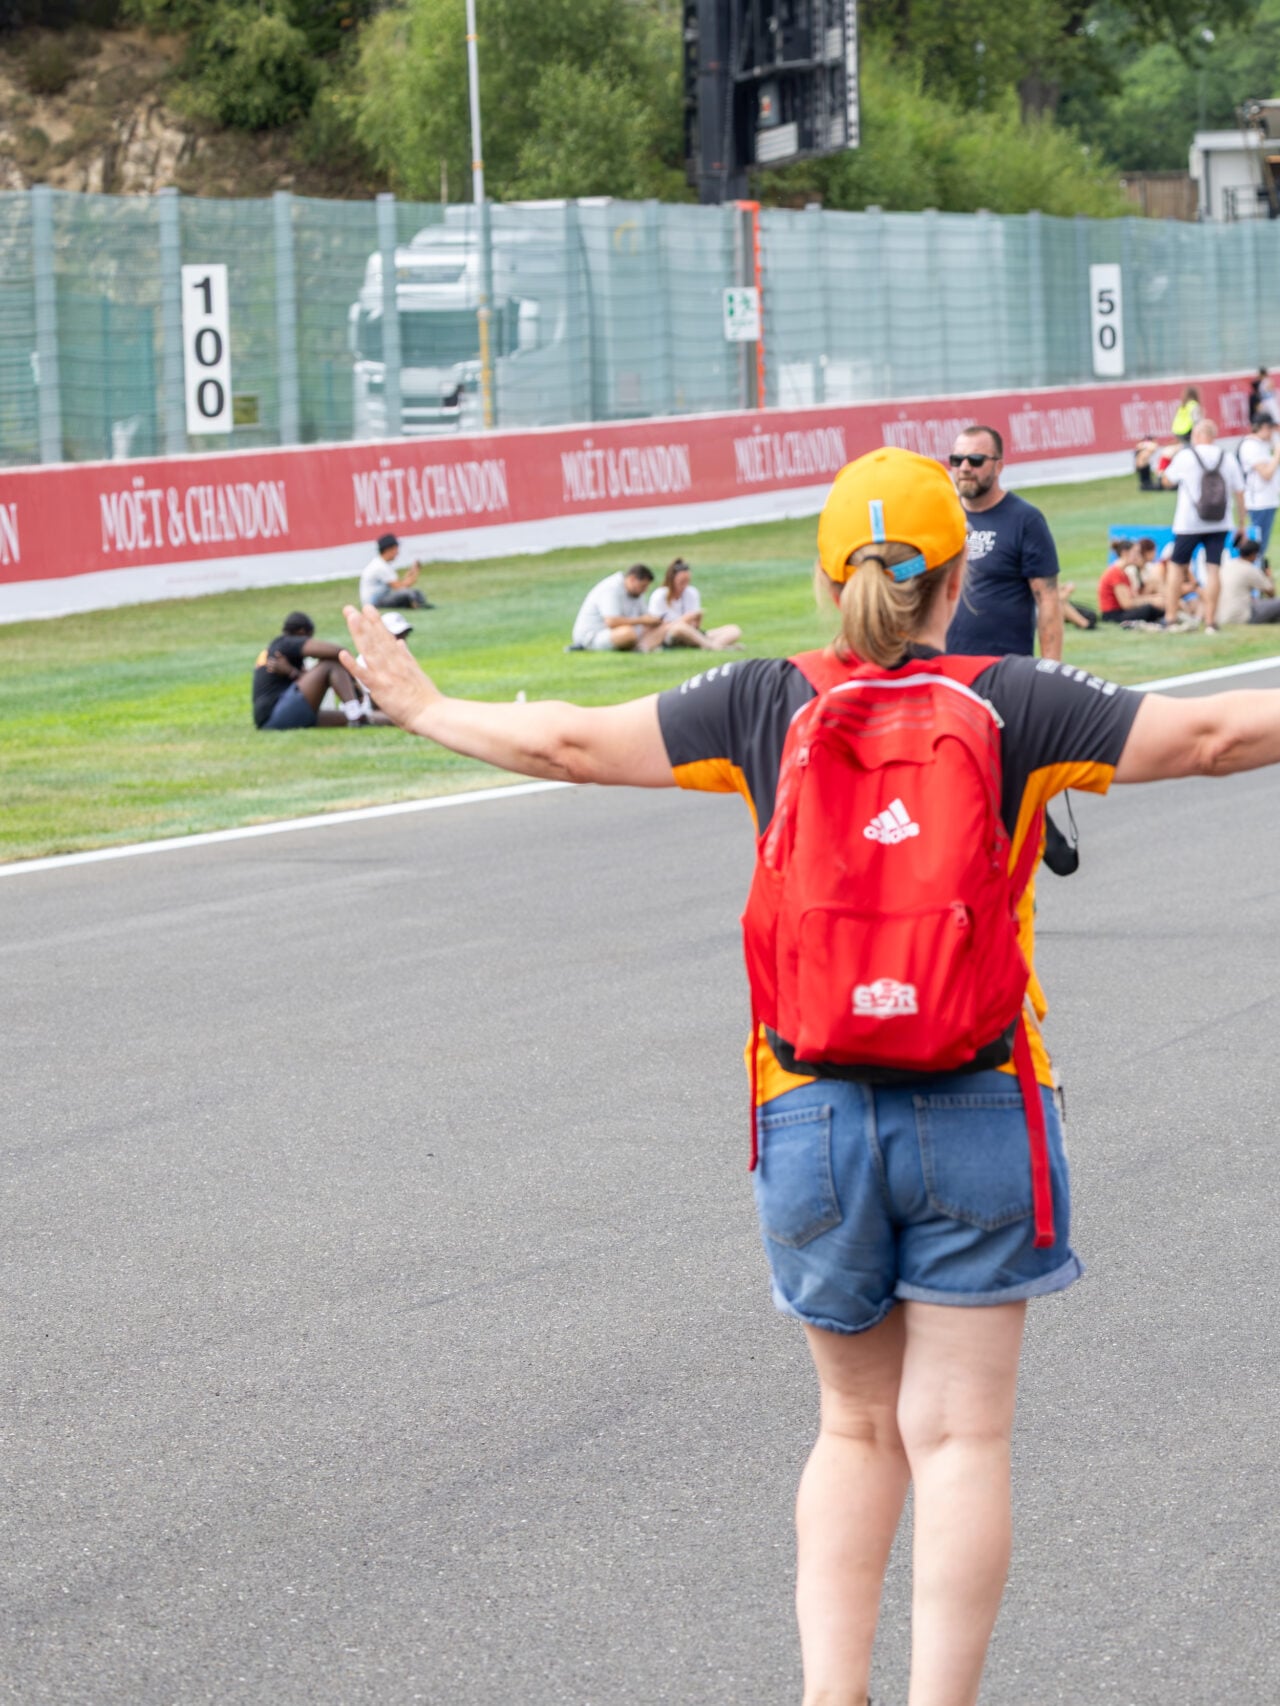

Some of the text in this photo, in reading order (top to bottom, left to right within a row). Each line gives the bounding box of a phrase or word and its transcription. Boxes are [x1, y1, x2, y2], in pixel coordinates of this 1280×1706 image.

[192, 276, 224, 418] 100
[1098, 290, 1116, 350] 50
[100, 475, 289, 553] MOËT & CHANDON
[352, 457, 407, 527] MOËT
[422, 459, 509, 518] CHANDON
